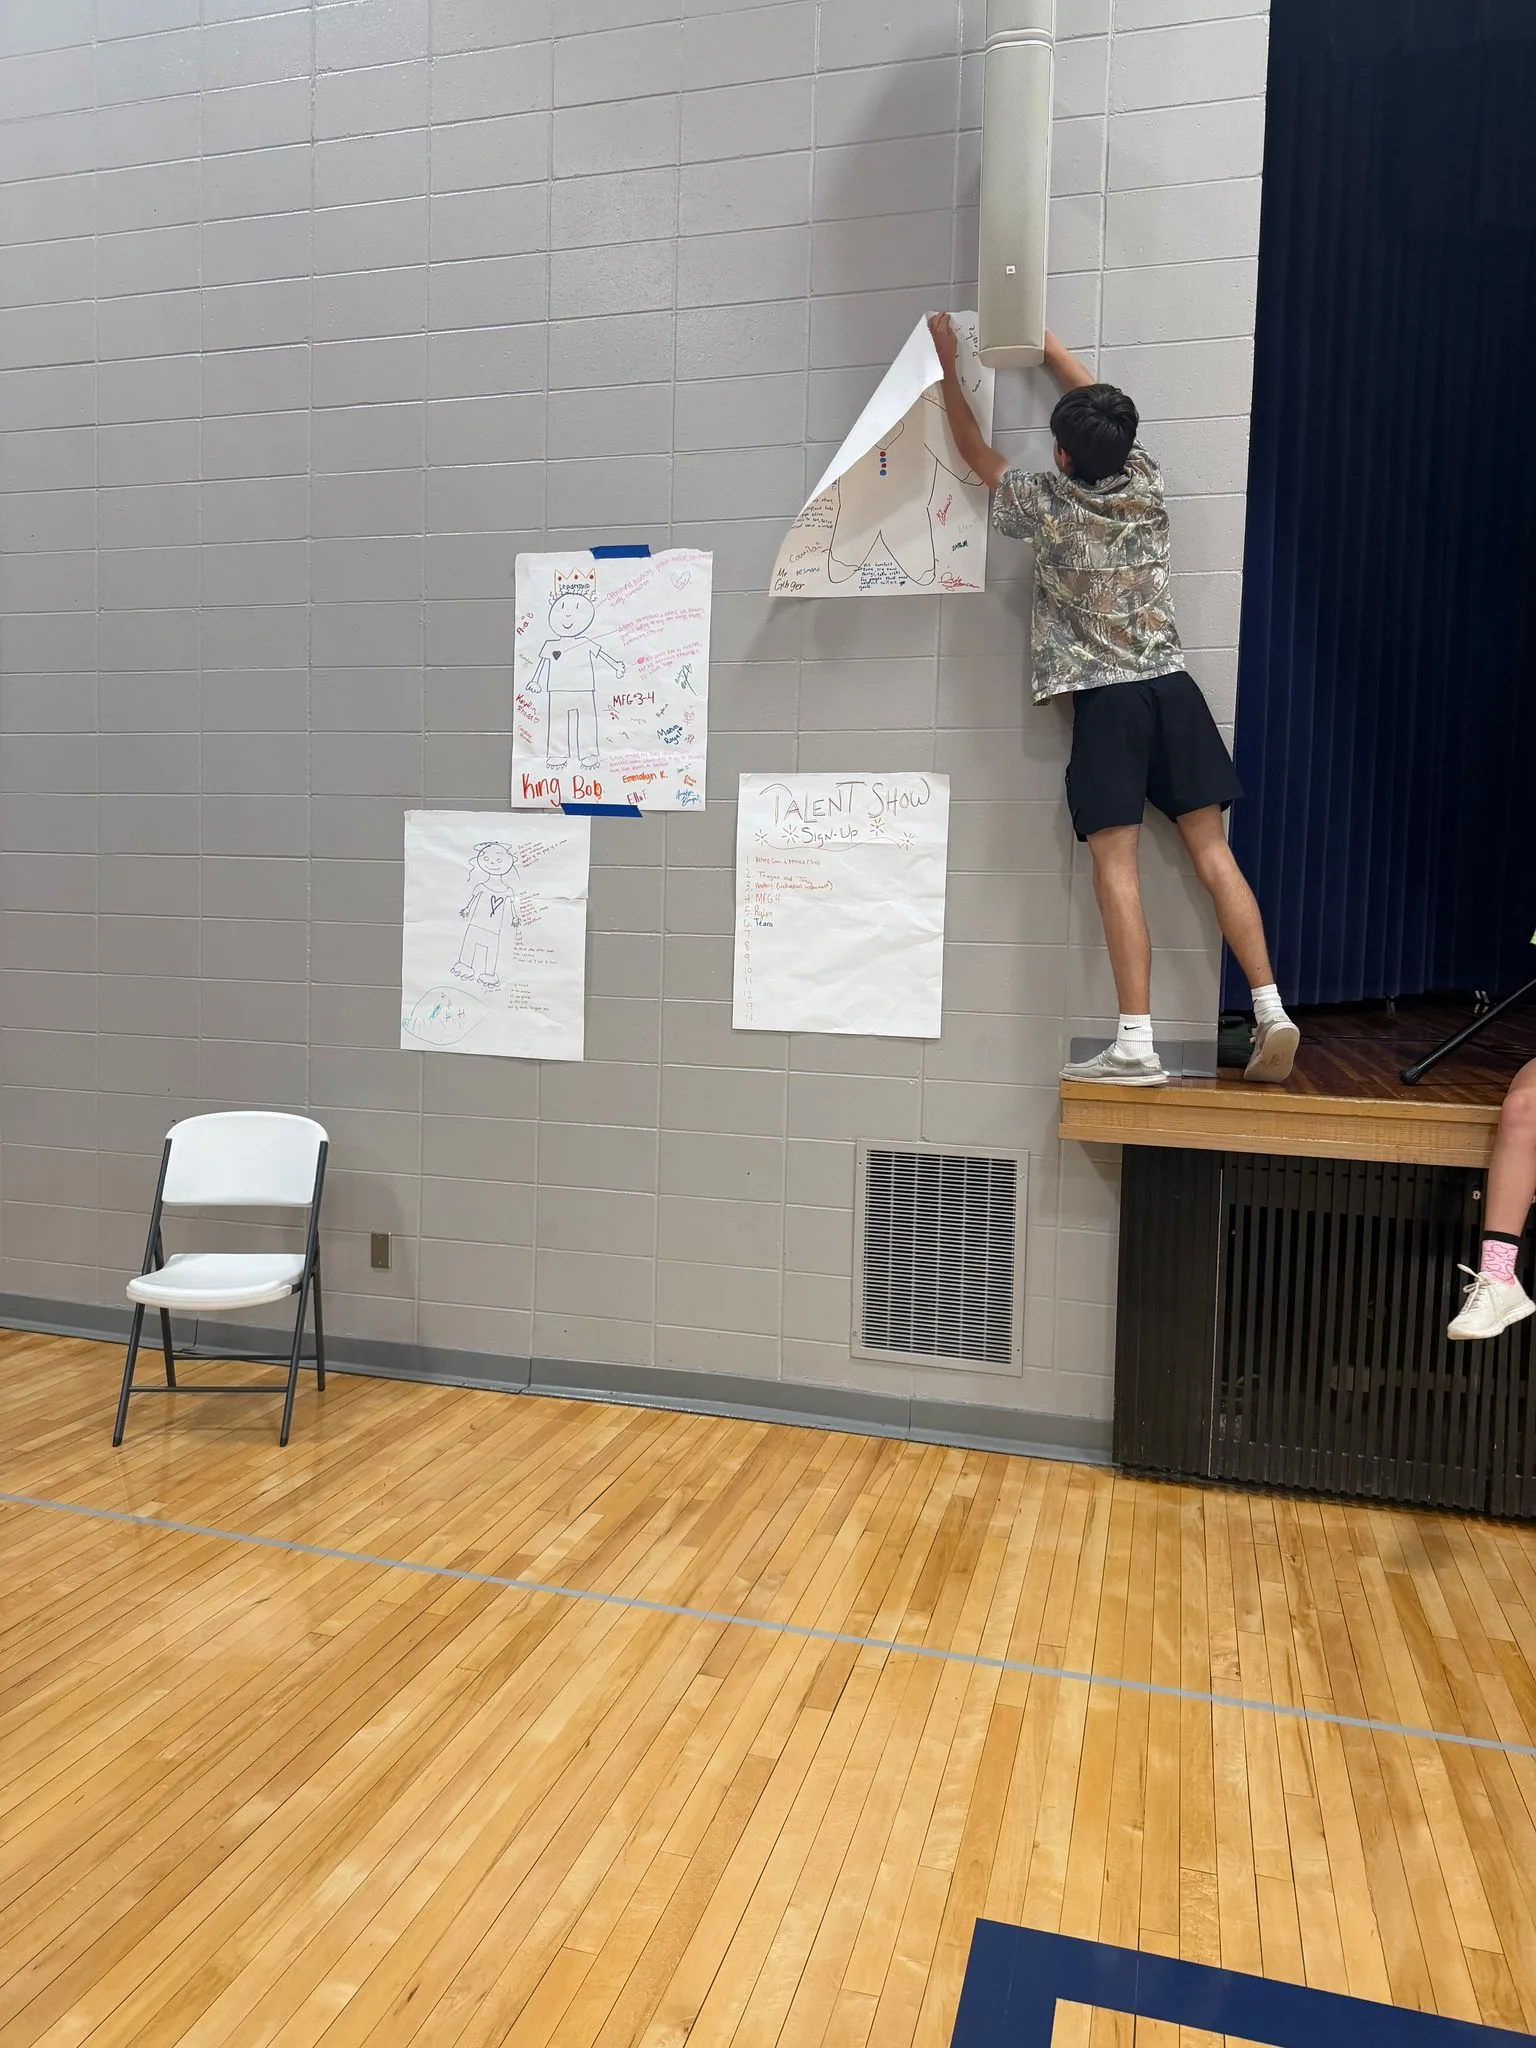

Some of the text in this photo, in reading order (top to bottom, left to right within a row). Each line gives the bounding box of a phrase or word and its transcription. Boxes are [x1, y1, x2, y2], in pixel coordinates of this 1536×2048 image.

[521, 772, 603, 808] King Bob
[758, 776, 930, 827] TALENT SHOW
